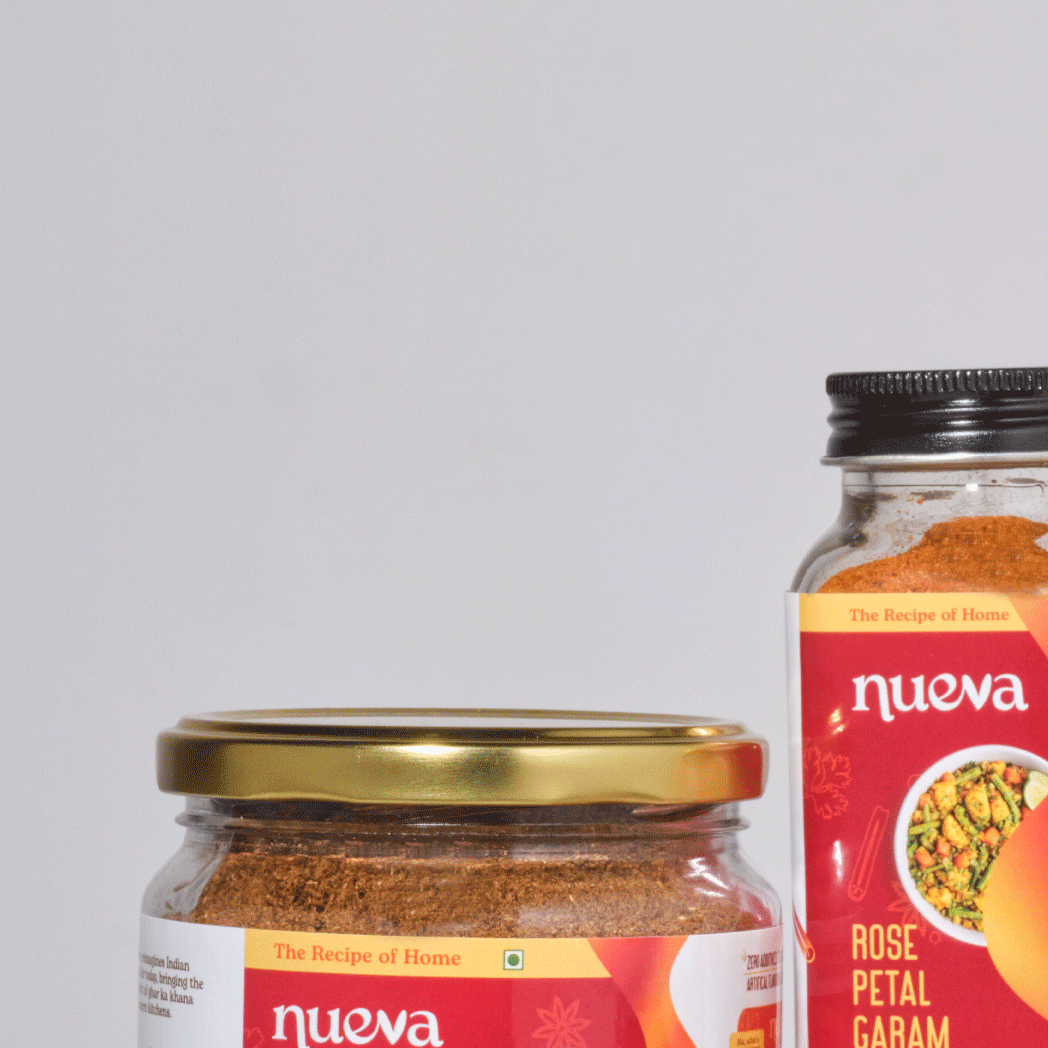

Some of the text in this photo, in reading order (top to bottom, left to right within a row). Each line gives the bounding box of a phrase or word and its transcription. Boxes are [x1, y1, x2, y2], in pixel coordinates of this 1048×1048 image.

[850, 608, 1009, 624] The Recipe of Home
[852, 672, 1029, 723] nueva
[852, 923, 918, 961] ROSE
[166, 956, 190, 972] Indian
[273, 943, 462, 967] The Recipe of Home
[159, 970, 188, 990] bringing
[189, 976, 204, 989] the
[852, 969, 931, 1006] PETAL
[160, 988, 168, 1001] ka
[169, 989, 194, 1004] khana
